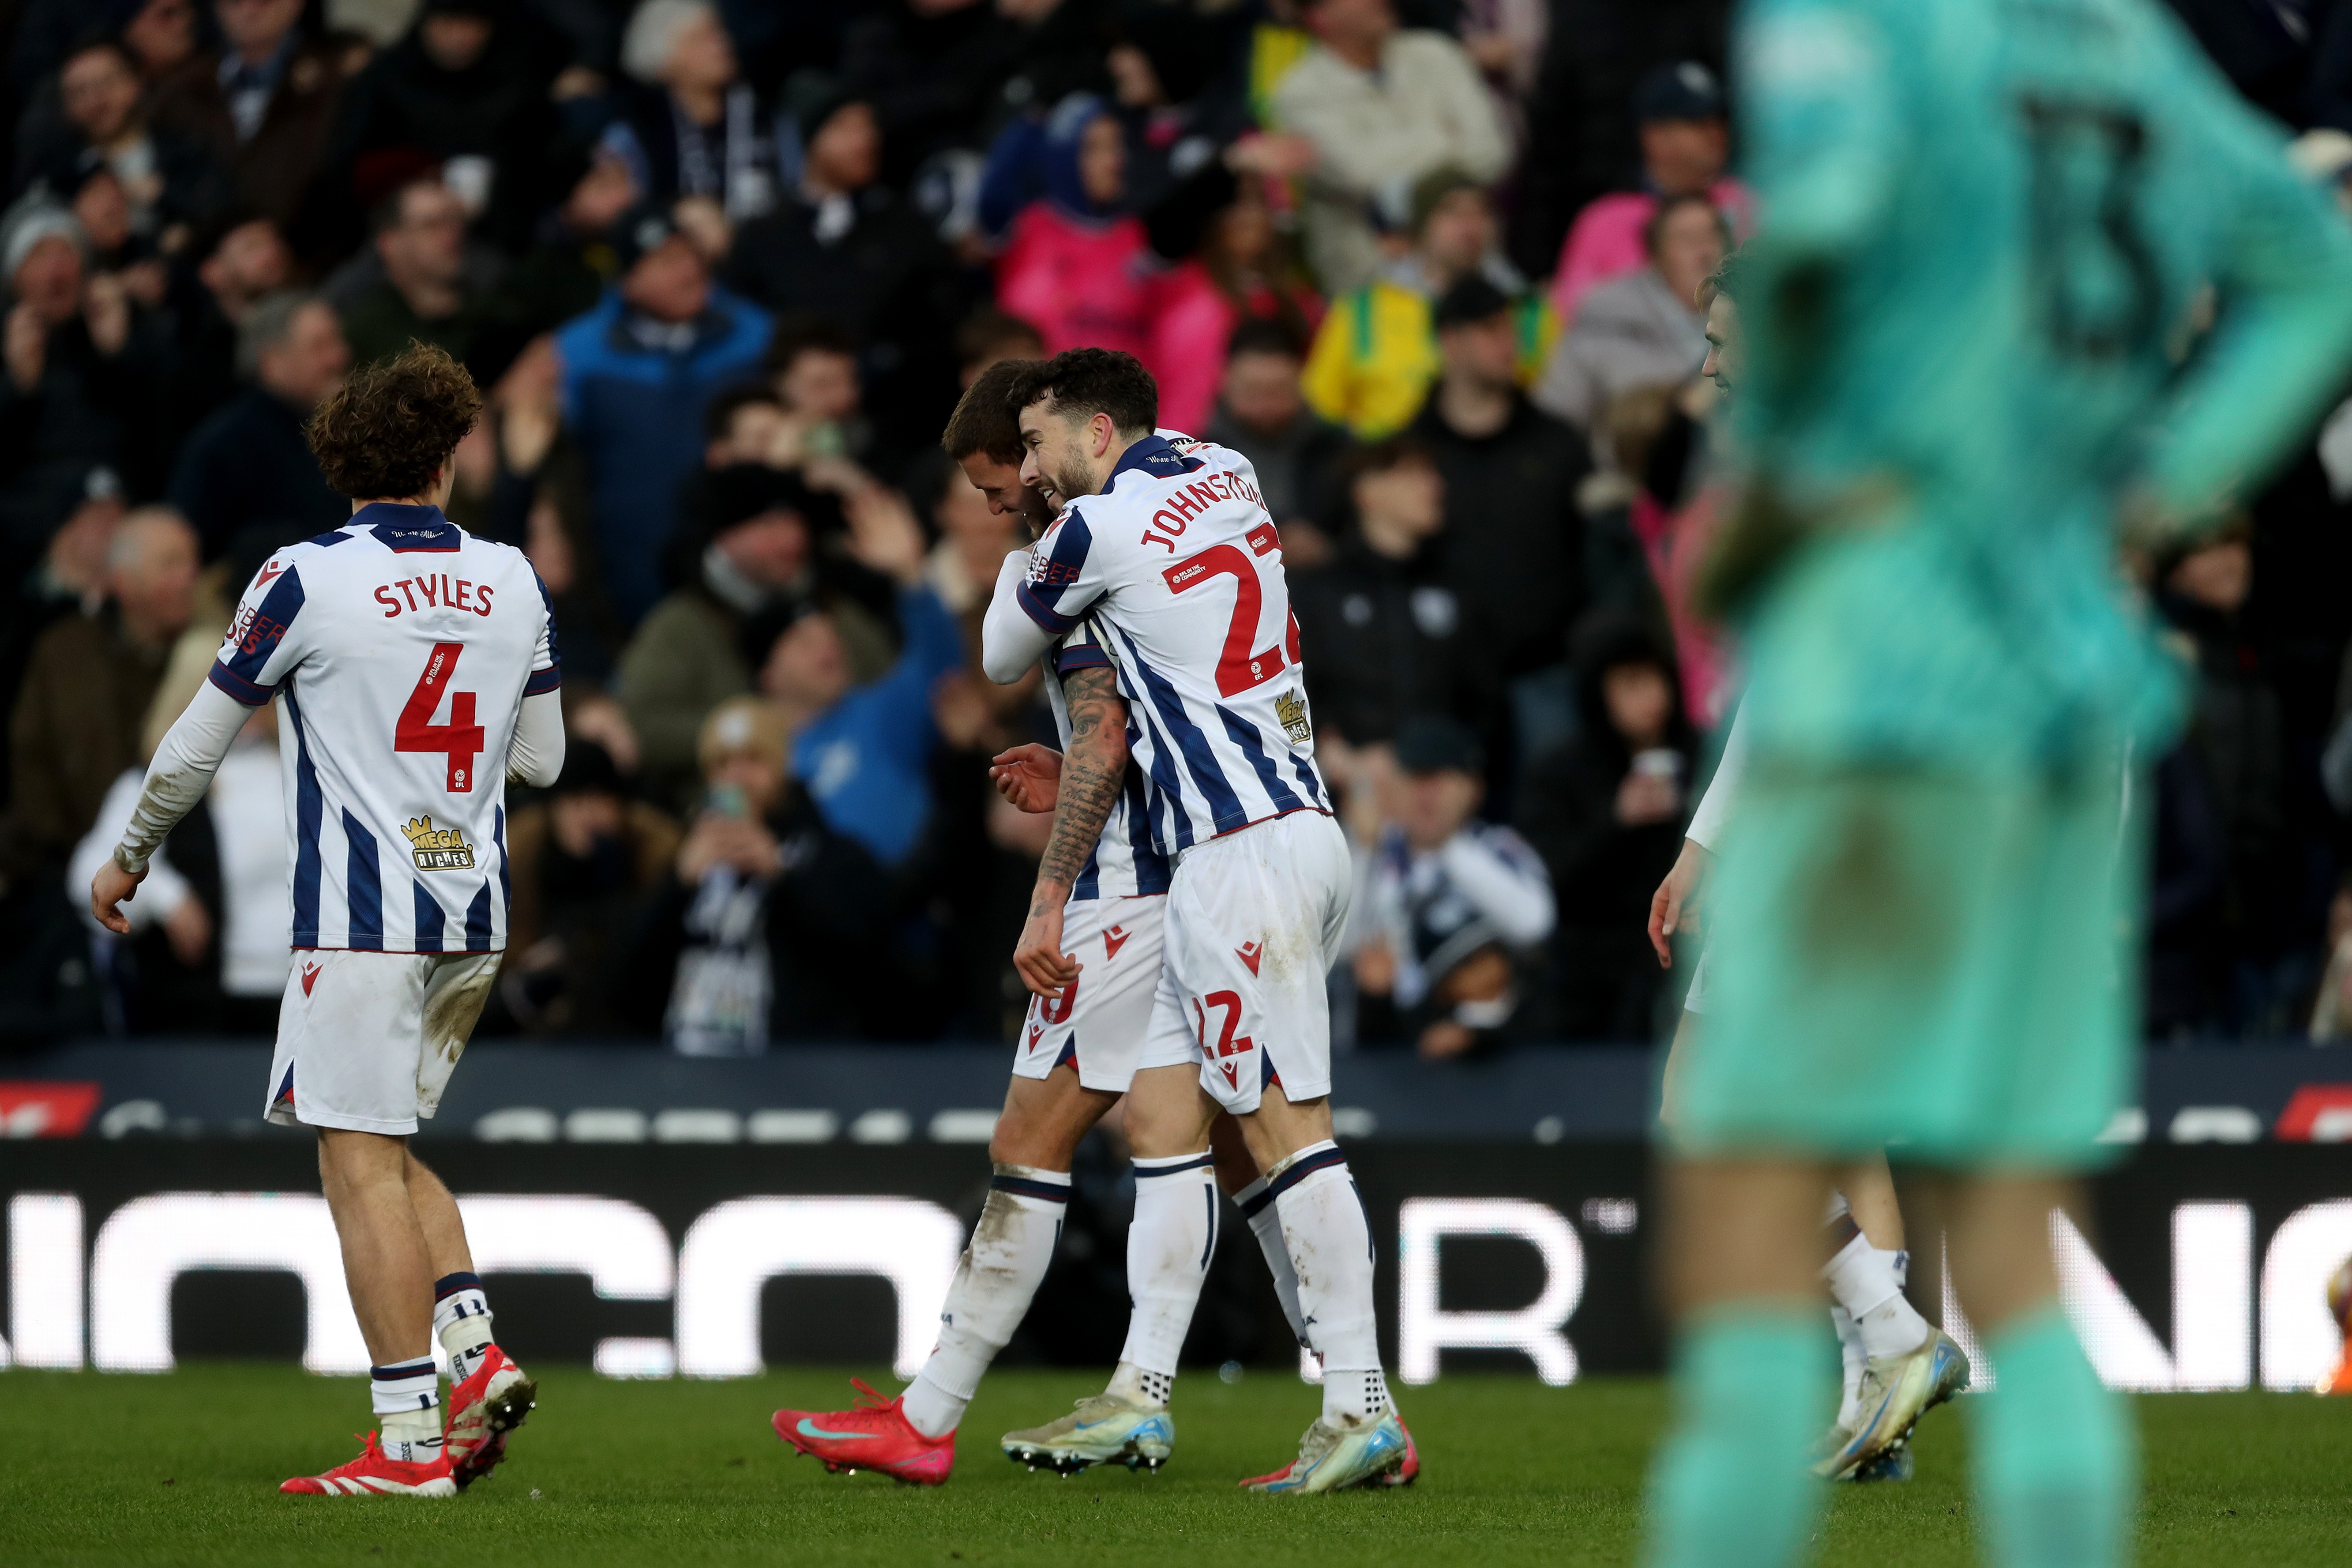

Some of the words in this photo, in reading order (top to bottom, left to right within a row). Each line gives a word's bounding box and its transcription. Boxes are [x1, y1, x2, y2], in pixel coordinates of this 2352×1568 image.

[1141, 471, 1269, 554] JOHNSTON
[420, 530, 444, 539] Albion
[1181, 565, 1206, 581] COMMUNITY
[374, 573, 494, 618] STYLES
[432, 652, 445, 678] COMMUNITY
[394, 643, 485, 793] 4
[1279, 700, 1305, 724] MEGA
[413, 829, 465, 849] MEGA
[417, 852, 469, 867] RICHES
